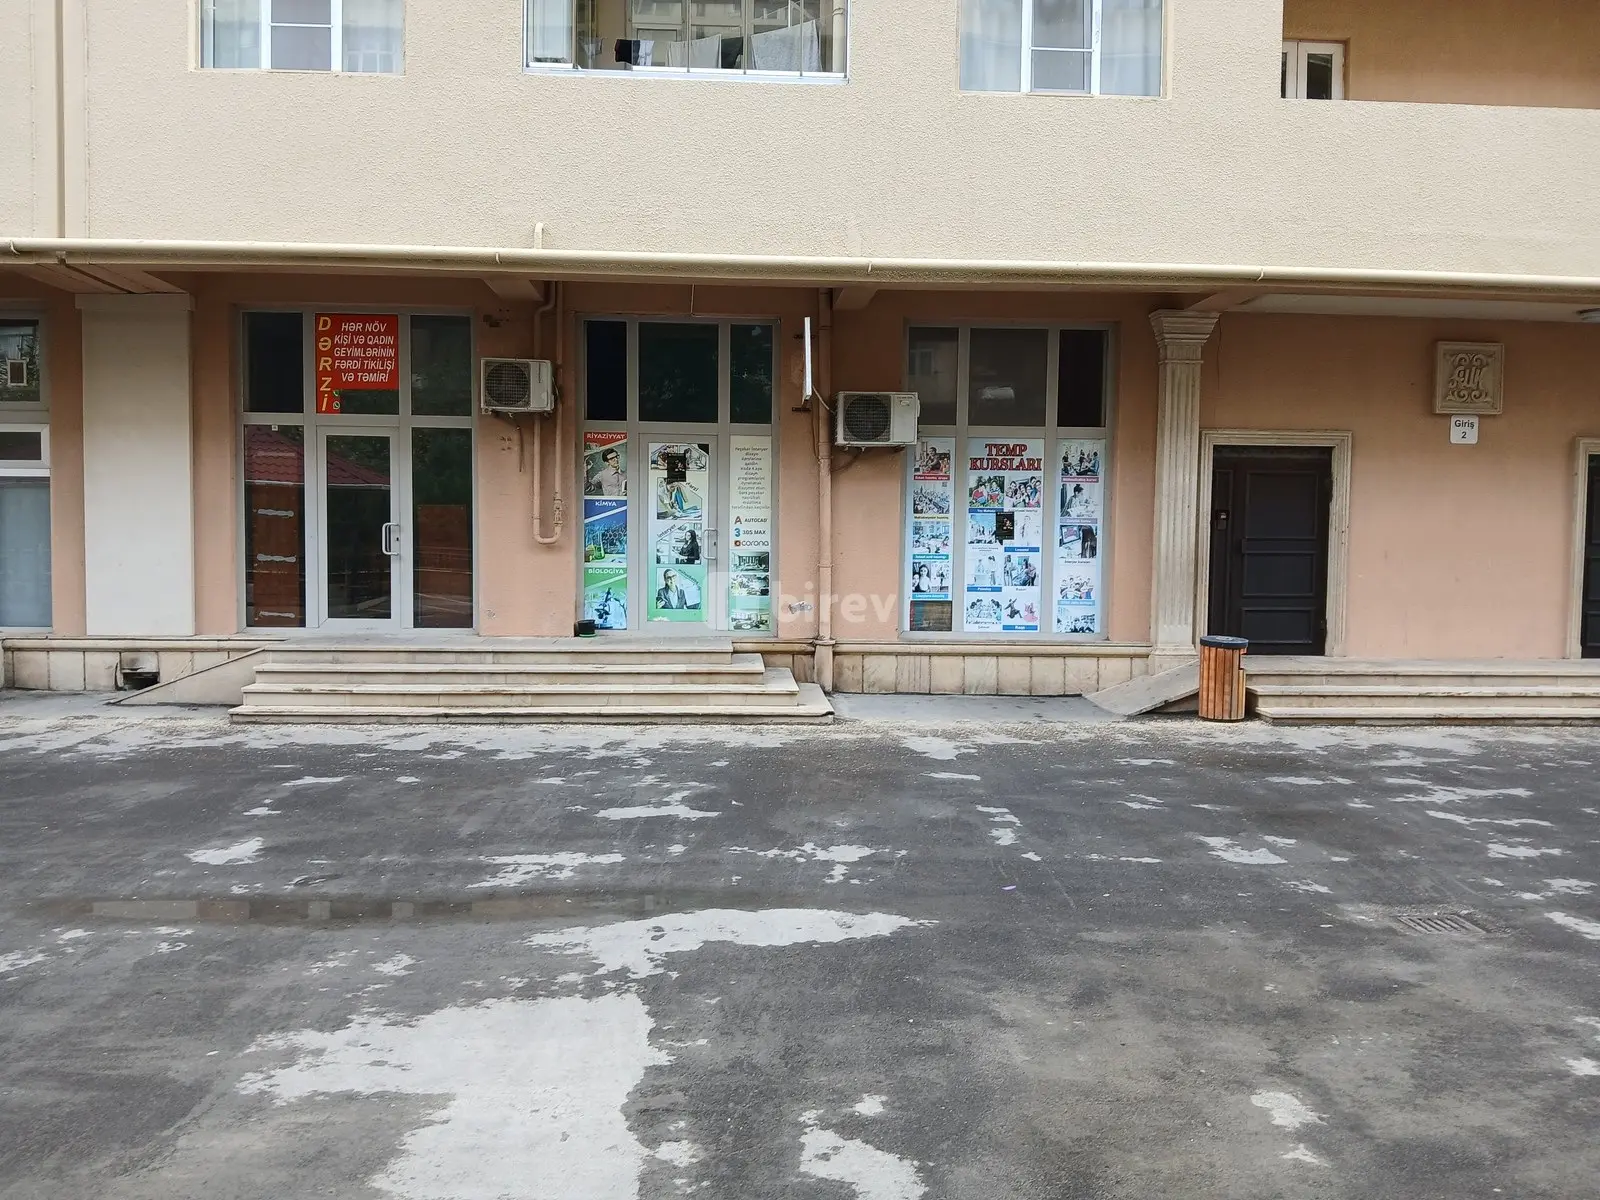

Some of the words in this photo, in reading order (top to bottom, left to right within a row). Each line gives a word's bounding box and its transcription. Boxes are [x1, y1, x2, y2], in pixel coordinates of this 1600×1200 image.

[341, 322, 363, 332] HƏR
[365, 320, 387, 332] NÖV
[334, 333, 352, 346] KİŞİ
[353, 335, 365, 345] VƏ
[367, 335, 394, 345] QADIN
[333, 346, 395, 357] GEYİMLƏRİNİN
[334, 358, 362, 370] FƏRDİ
[363, 358, 395, 372] TİKİLİŞİ
[341, 372, 355, 382] VƏ
[357, 371, 390, 382] TƏMİRİ
[1454, 419, 1475, 429] Giriş
[586, 432, 625, 440] RİYAZİYYAT
[1461, 431, 1467, 439] 2
[984, 443, 1028, 457] TEMP
[969, 457, 1042, 471] KURSLARI
